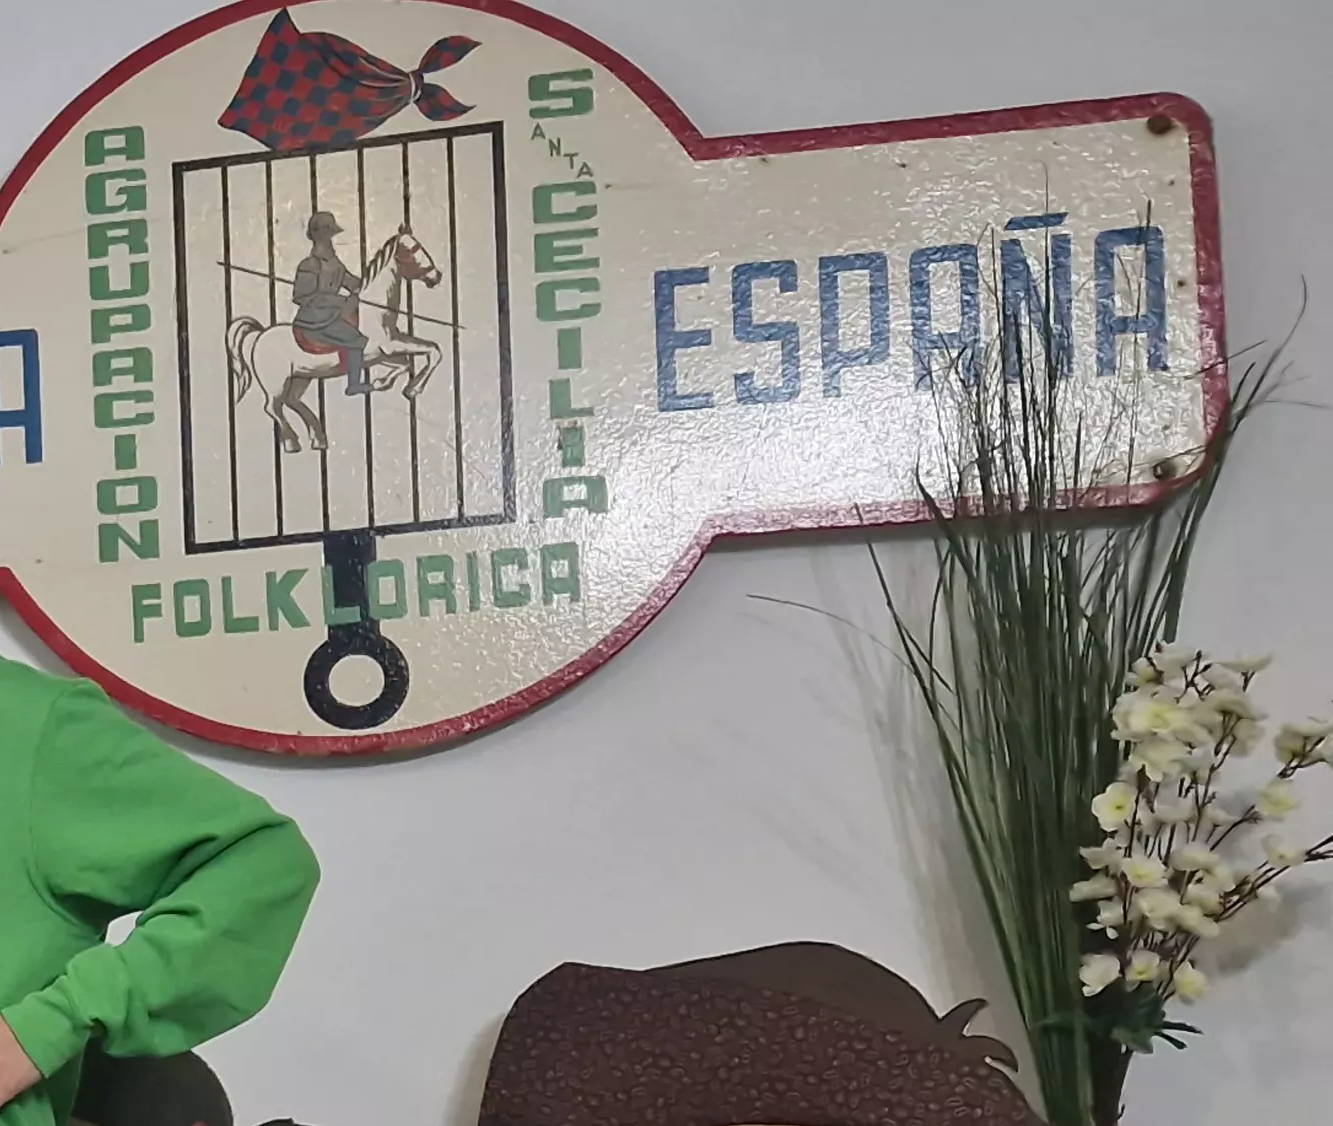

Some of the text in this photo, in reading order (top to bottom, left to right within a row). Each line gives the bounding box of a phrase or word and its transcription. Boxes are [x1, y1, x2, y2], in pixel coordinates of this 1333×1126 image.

[84, 125, 161, 563] AGRUPACION
[528, 68, 610, 519] SANTA CECILIA
[654, 211, 1169, 412] ESPAÑA
[131, 541, 582, 644] FOLKLORICA
